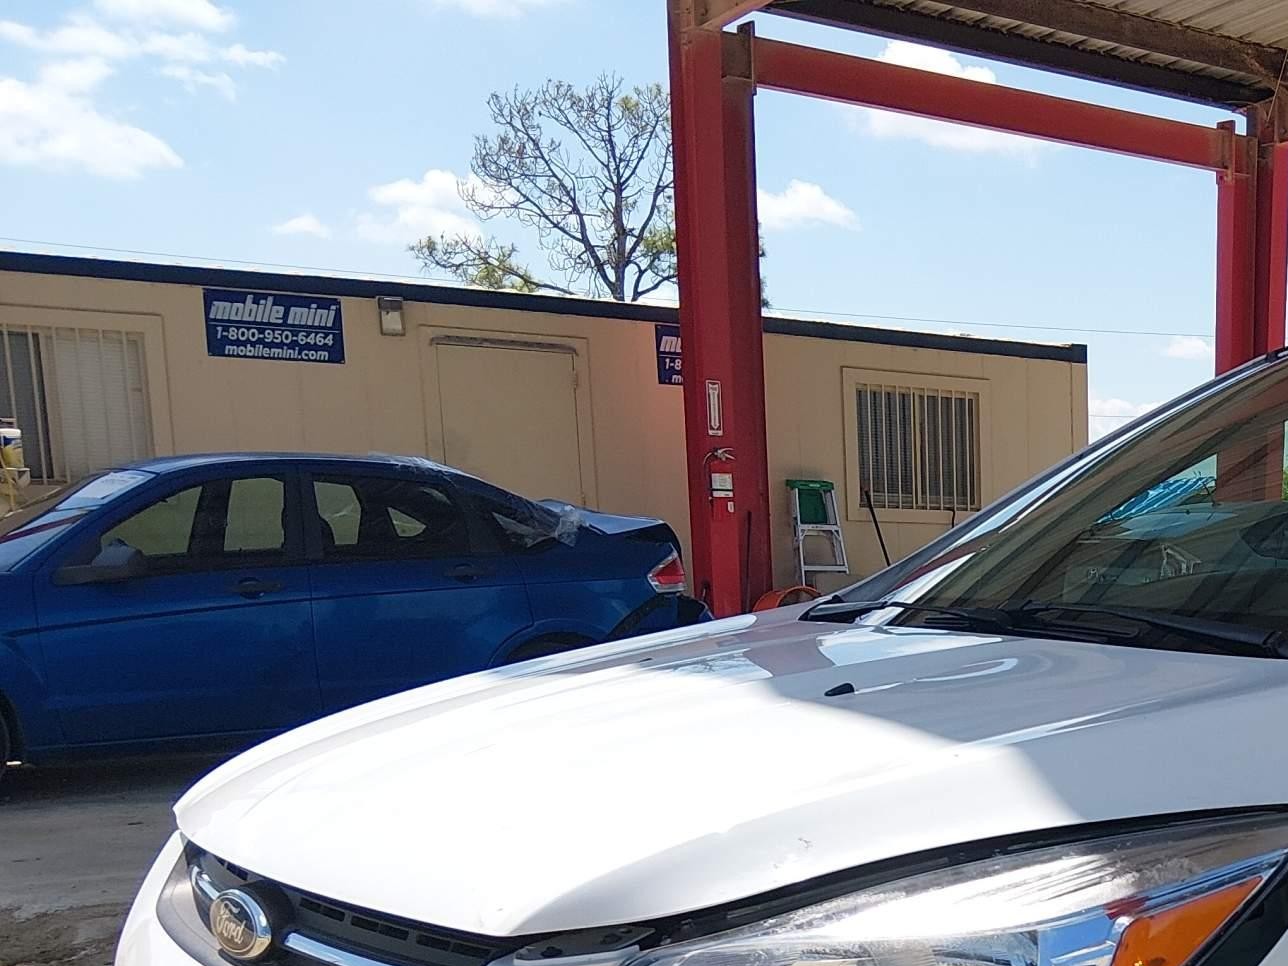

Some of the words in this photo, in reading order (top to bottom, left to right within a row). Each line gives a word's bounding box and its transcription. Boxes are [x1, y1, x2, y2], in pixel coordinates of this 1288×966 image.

[209, 294, 285, 324] mobile
[287, 303, 337, 328] mini
[215, 326, 334, 346] 1-800-950-6464
[224, 343, 329, 361] mobilemini.com
